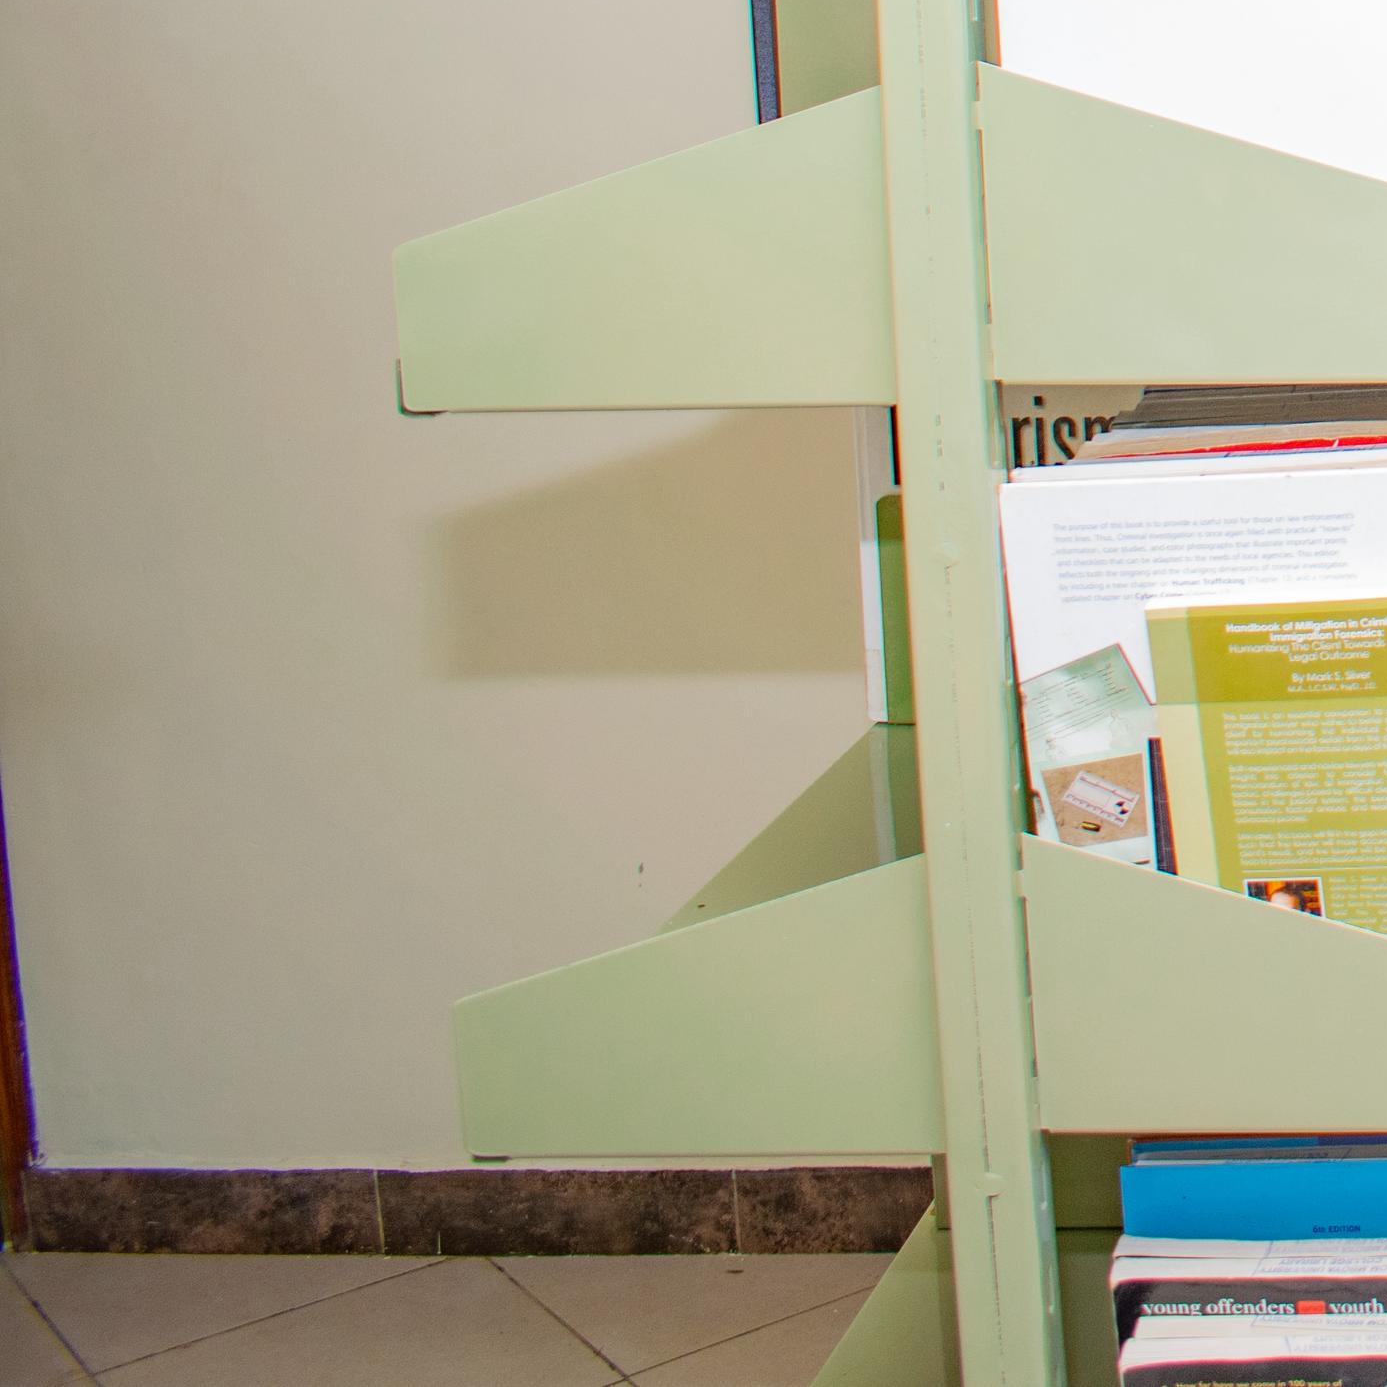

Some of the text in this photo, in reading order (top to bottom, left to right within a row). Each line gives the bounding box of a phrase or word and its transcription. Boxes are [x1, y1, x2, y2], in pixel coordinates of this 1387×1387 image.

[1171, 575, 1246, 587] Human Trafficking
[1225, 622, 1281, 633] Handbook
[1282, 620, 1294, 632] of
[1295, 619, 1346, 632] Mitigation
[1348, 618, 1359, 629] in
[1270, 628, 1385, 643] Immigration Forensics:
[1228, 643, 1289, 654] Humanizing
[1291, 641, 1310, 652] The
[1311, 640, 1342, 651] Client
[1344, 639, 1385, 649] Towards
[1288, 649, 1370, 664] Legal Outcome
[1291, 673, 1304, 685] By
[1306, 671, 1333, 682] Mark
[1344, 669, 1372, 680] Silver
[1312, 1224, 1361, 1234] 6th EDITION
[1141, 1301, 1202, 1316] young
[1205, 1297, 1296, 1315] offenders
[1329, 1297, 1384, 1314] youth
